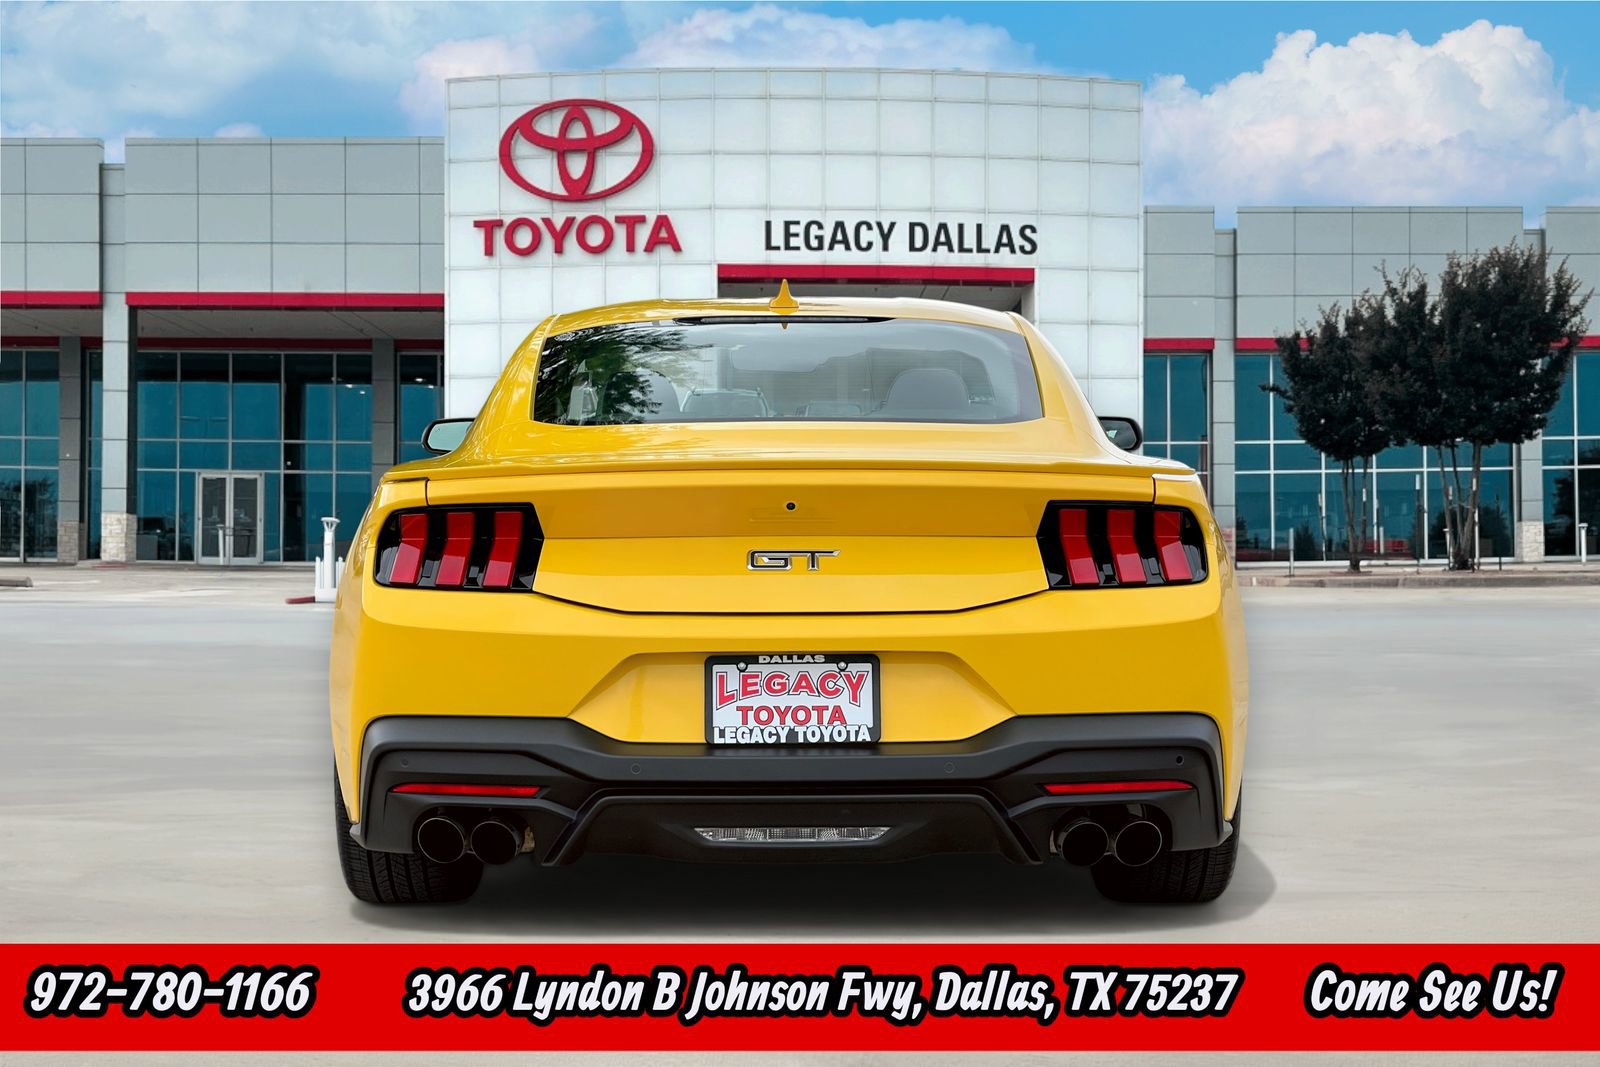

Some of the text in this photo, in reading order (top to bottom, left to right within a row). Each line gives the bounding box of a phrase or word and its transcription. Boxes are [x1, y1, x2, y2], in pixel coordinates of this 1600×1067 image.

[473, 214, 683, 257] TOYOTA
[765, 220, 1038, 255] LEGACY DALLAS
[747, 549, 840, 571] GT
[758, 654, 826, 664] DALLAS
[716, 670, 869, 710] LEGACY
[736, 705, 847, 726] TOYOTA
[713, 724, 871, 744] LEGACY TOYOTA
